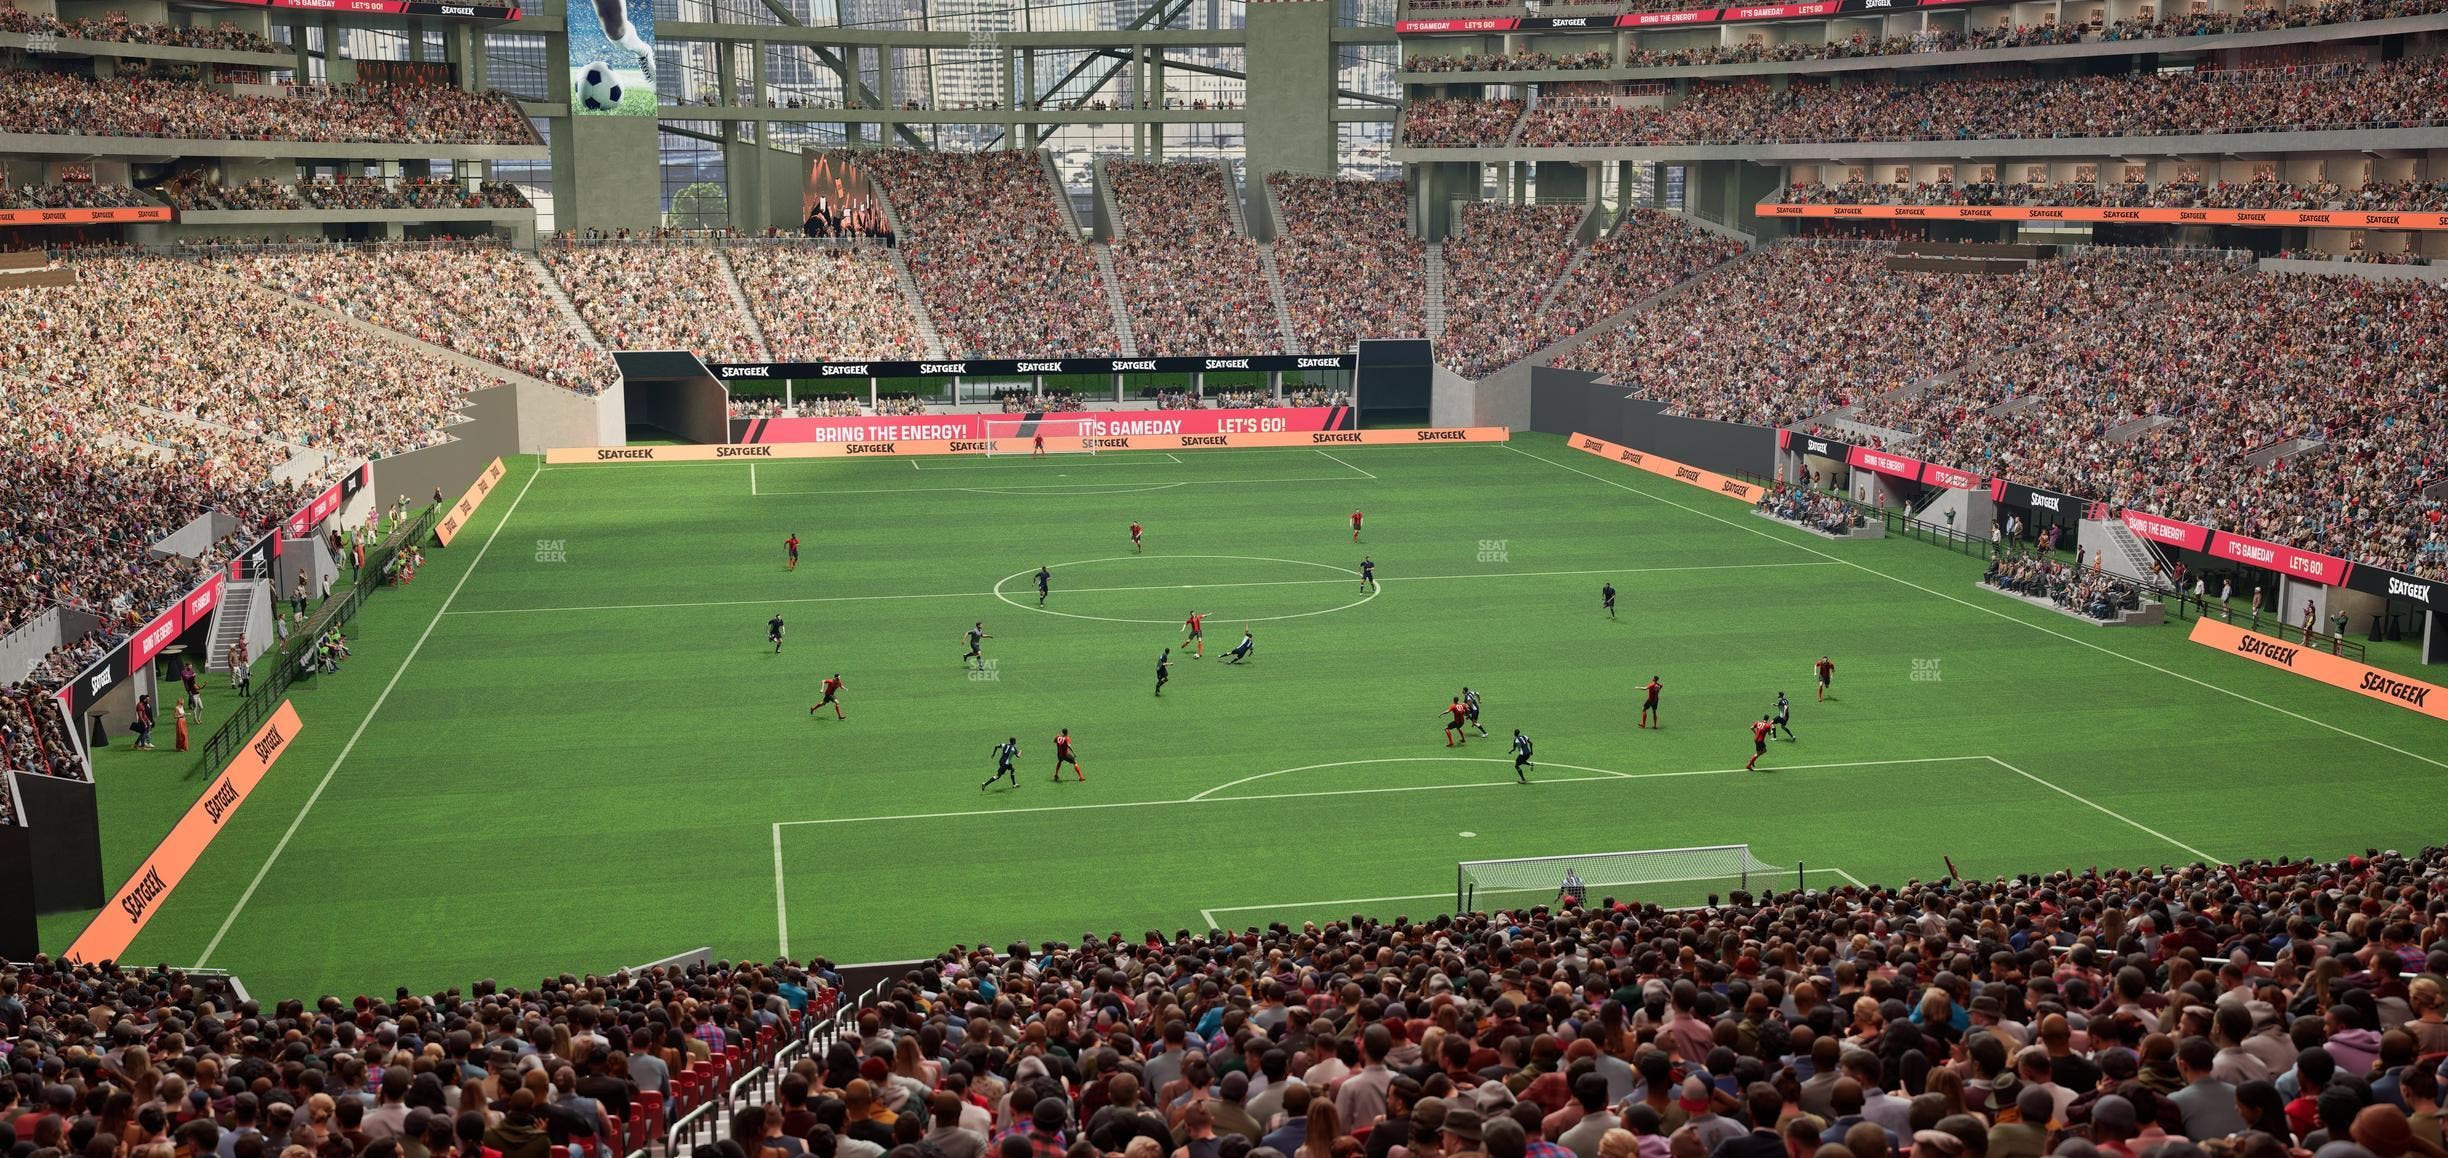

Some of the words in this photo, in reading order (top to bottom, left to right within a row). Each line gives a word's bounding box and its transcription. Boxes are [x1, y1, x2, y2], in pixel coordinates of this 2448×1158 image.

[1865, 0, 1892, 8] SEATGEEK
[441, 6, 474, 16] SEATGEEK
[1740, 9, 1753, 17] IT'S
[1753, 8, 1784, 16] GAMEDAY
[1799, 6, 1812, 14] LET'S
[1813, 5, 1824, 13] GO!
[1552, 18, 1586, 27] SEATGEEK
[1671, 13, 1697, 21] ENERGY!
[1419, 22, 1450, 30] GAMEDAY
[1465, 21, 1482, 29] LET'S
[92, 211, 114, 219] SEATGEEK
[138, 210, 160, 218] SEATGEEK
[1834, 207, 1862, 215] SEATGEEK
[1895, 208, 1925, 216] SEATGEEK
[1960, 208, 1992, 217] SEATGEEK
[2029, 209, 2063, 218] SEATGEEK
[2103, 210, 2139, 219] SEATGEEK
[2180, 211, 2207, 220] SEATGEEK
[0, 213, 15, 221] GEEK
[42, 213, 67, 221] SEATGEEK
[2237, 213, 2266, 222] SEATGEEK
[2299, 214, 2330, 223] SEATGEEK
[2366, 215, 2400, 224] SEATGEEK
[1017, 362, 1062, 373] SEATGEEK
[1112, 361, 1156, 371] SEATGEEK
[1205, 359, 1249, 369] SEATGEEK
[1297, 357, 1340, 368] SEATGEEK
[722, 366, 770, 377] SEATGEEK
[822, 365, 868, 376] SEATGEEK
[920, 363, 966, 374] SEATGEEK
[1110, 420, 1182, 435] GAMEDAY
[1218, 418, 1257, 433] LET'S
[1261, 417, 1286, 432] GO!
[815, 426, 864, 442] BRING
[868, 426, 898, 441] THE
[901, 424, 967, 440] ENERGY!
[1312, 433, 1362, 443] SEATGEEK
[1418, 430, 1466, 441] SEATGEEK
[1181, 436, 1227, 446] SEATGEEK
[598, 448, 653, 460] SEATGEEK
[716, 446, 771, 457] SEATGEEK
[846, 443, 895, 454] SEATGEEK
[1676, 466, 1701, 482] SEATGEEK
[1722, 480, 1749, 498] SEATGEEK
[2031, 492, 2059, 512] SEATGEEK
[2148, 521, 2160, 535] THE
[2160, 524, 2185, 542] ENERGY!
[2229, 541, 2242, 555] IT'S
[2242, 544, 2274, 563] GAMEDAY
[2290, 555, 2309, 572] LET'S
[2309, 559, 2323, 575] GO!
[2388, 576, 2430, 604] SEATGEEK
[2238, 635, 2298, 667] SEATGEEK
[2359, 671, 2431, 708] SEATGEEK
[254, 723, 284, 764] SEATGEEK
[204, 777, 239, 824] SEATGEEK
[122, 864, 167, 924] SEATGEEK
